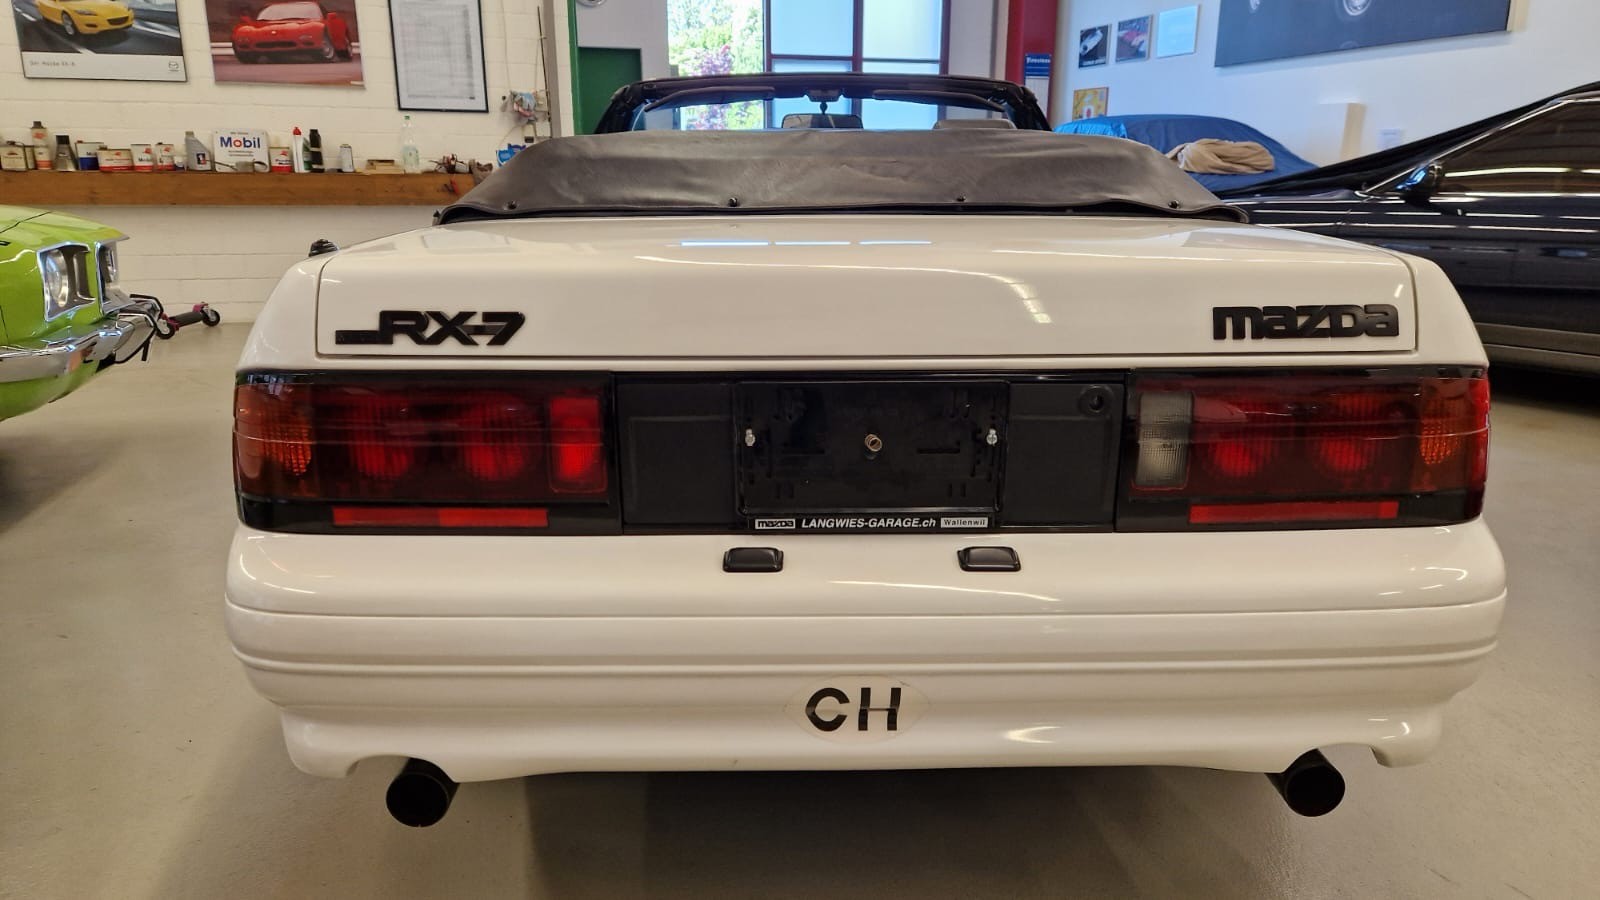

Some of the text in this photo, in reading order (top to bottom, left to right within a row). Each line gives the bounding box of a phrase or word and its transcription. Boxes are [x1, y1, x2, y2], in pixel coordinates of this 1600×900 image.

[220, 136, 261, 148] Mobil
[335, 310, 526, 346] RX-7
[802, 518, 936, 528] LANGWIES-GARAGE.ch
[943, 518, 985, 526] Wallenwil
[805, 687, 902, 732] CH
